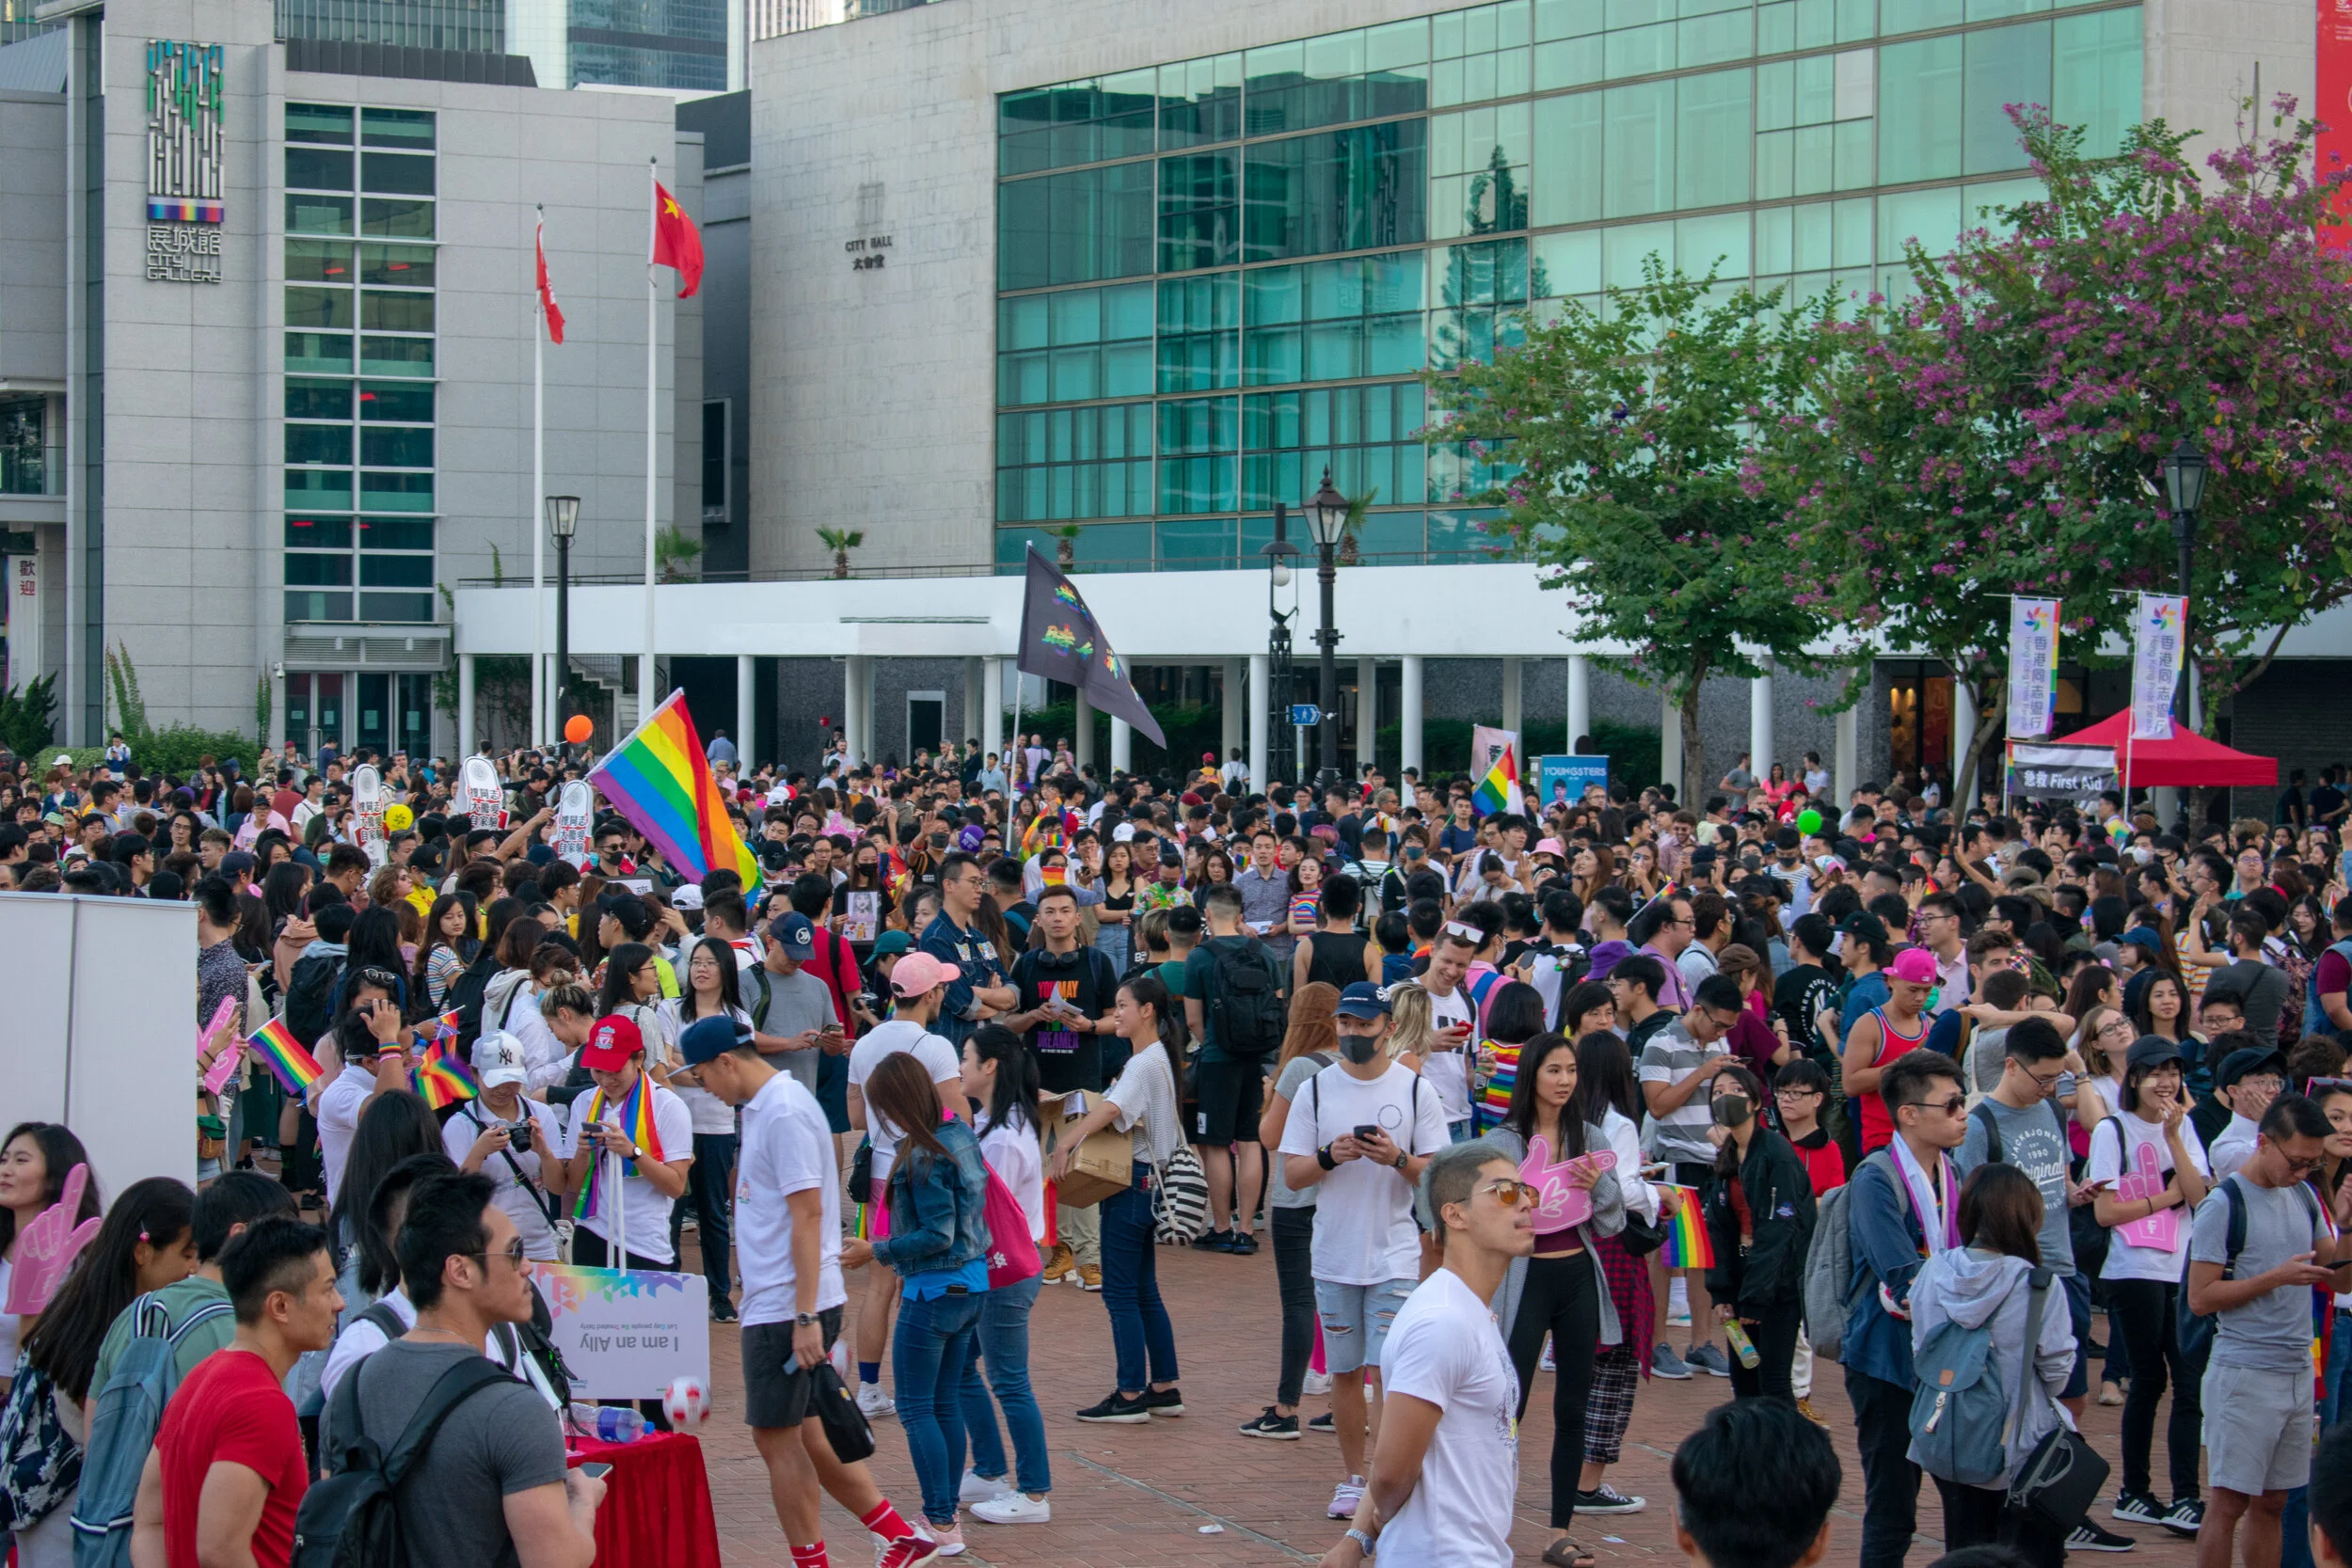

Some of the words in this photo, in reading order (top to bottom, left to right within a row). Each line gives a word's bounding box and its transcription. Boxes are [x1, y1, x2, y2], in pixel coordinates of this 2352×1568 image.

[147, 225, 223, 255] 展城館
[845, 239, 866, 253] CITY
[870, 235, 893, 248] HALL
[147, 253, 183, 268] CITY
[147, 266, 223, 283] GALLERY
[19, 560, 36, 596] 歡迎
[2024, 770, 2048, 788] 急救
[2050, 773, 2078, 790] First
[2081, 776, 2103, 791] Aid
[1800, 990, 1812, 1012] NEW
[1808, 978, 1826, 990] YORK
[1037, 1031, 1079, 1049] DREAMER
[2027, 1148, 2049, 1160] 1990
[580, 1333, 611, 1353] Ally
[615, 1336, 637, 1349] an
[642, 1336, 669, 1349] am
[675, 1336, 678, 1352] I
